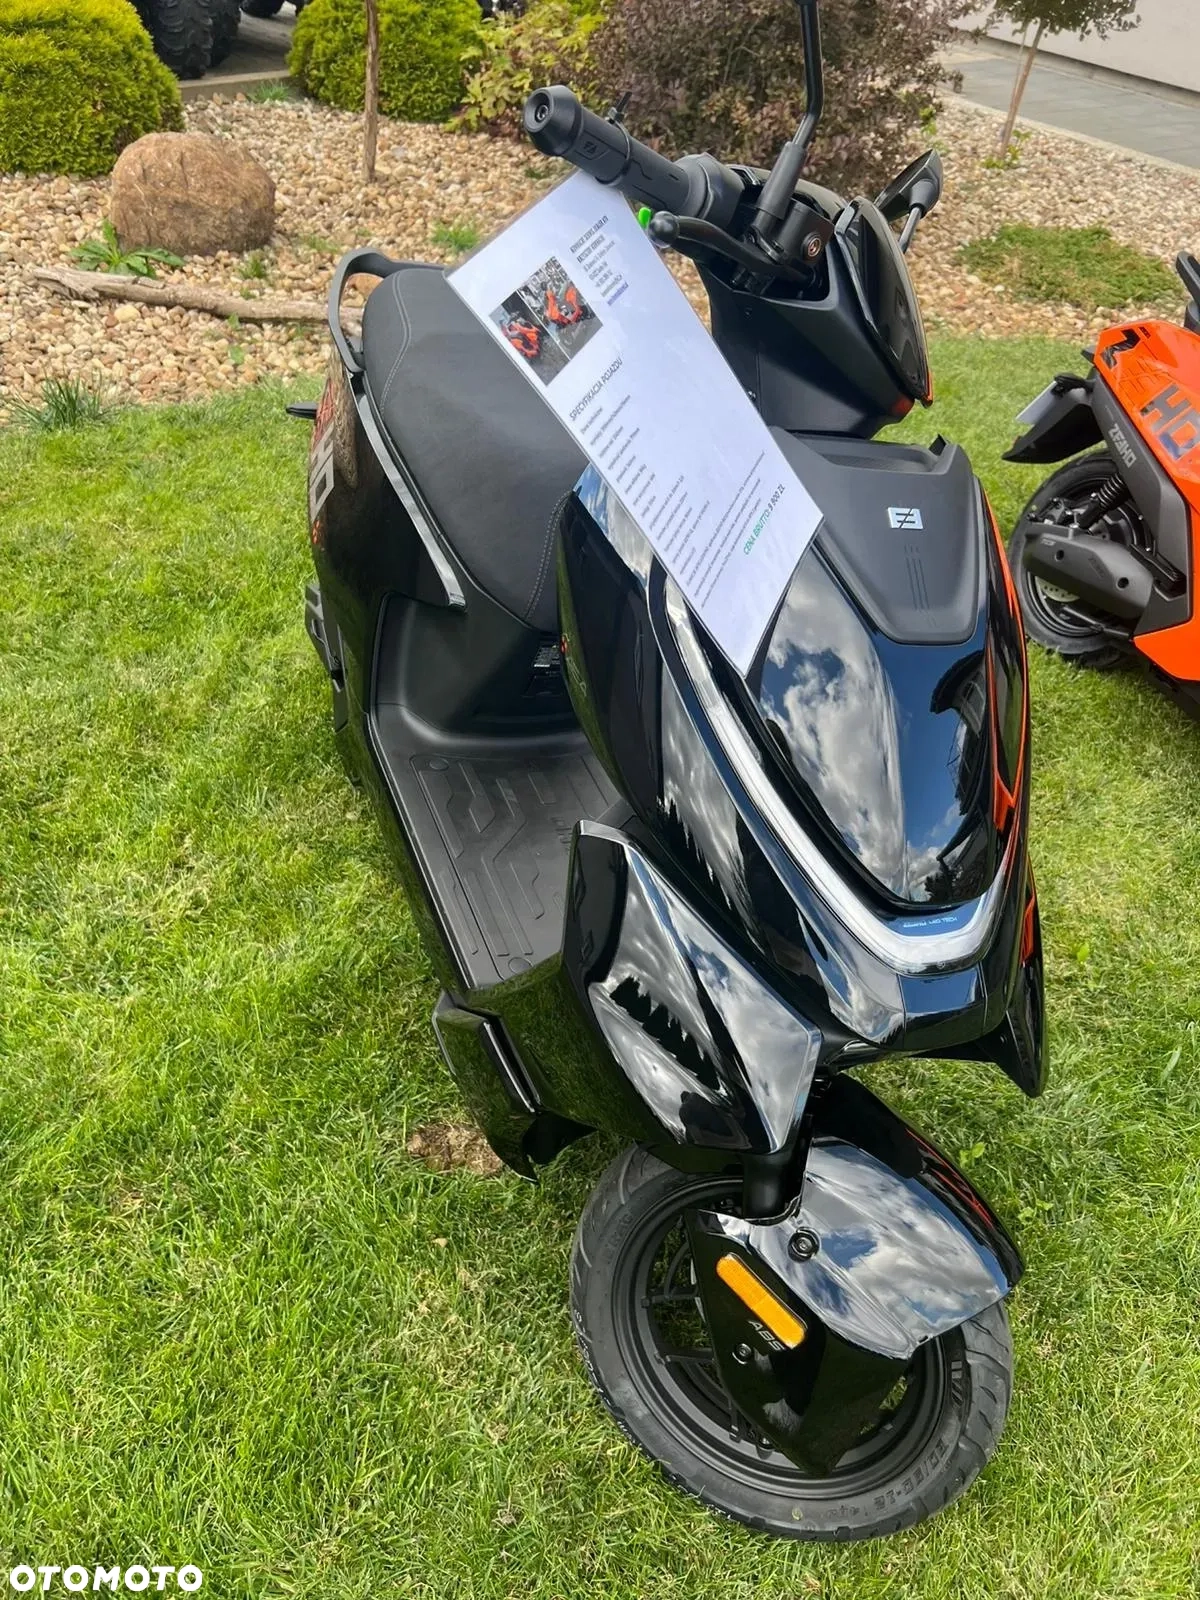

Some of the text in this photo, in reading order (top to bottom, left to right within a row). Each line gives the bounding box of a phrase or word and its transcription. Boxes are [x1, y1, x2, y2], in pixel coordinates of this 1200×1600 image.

[569, 379, 603, 422] SPECYFIKACJA
[601, 357, 623, 384] POJAZDU
[747, 1319, 786, 1353] ABS
